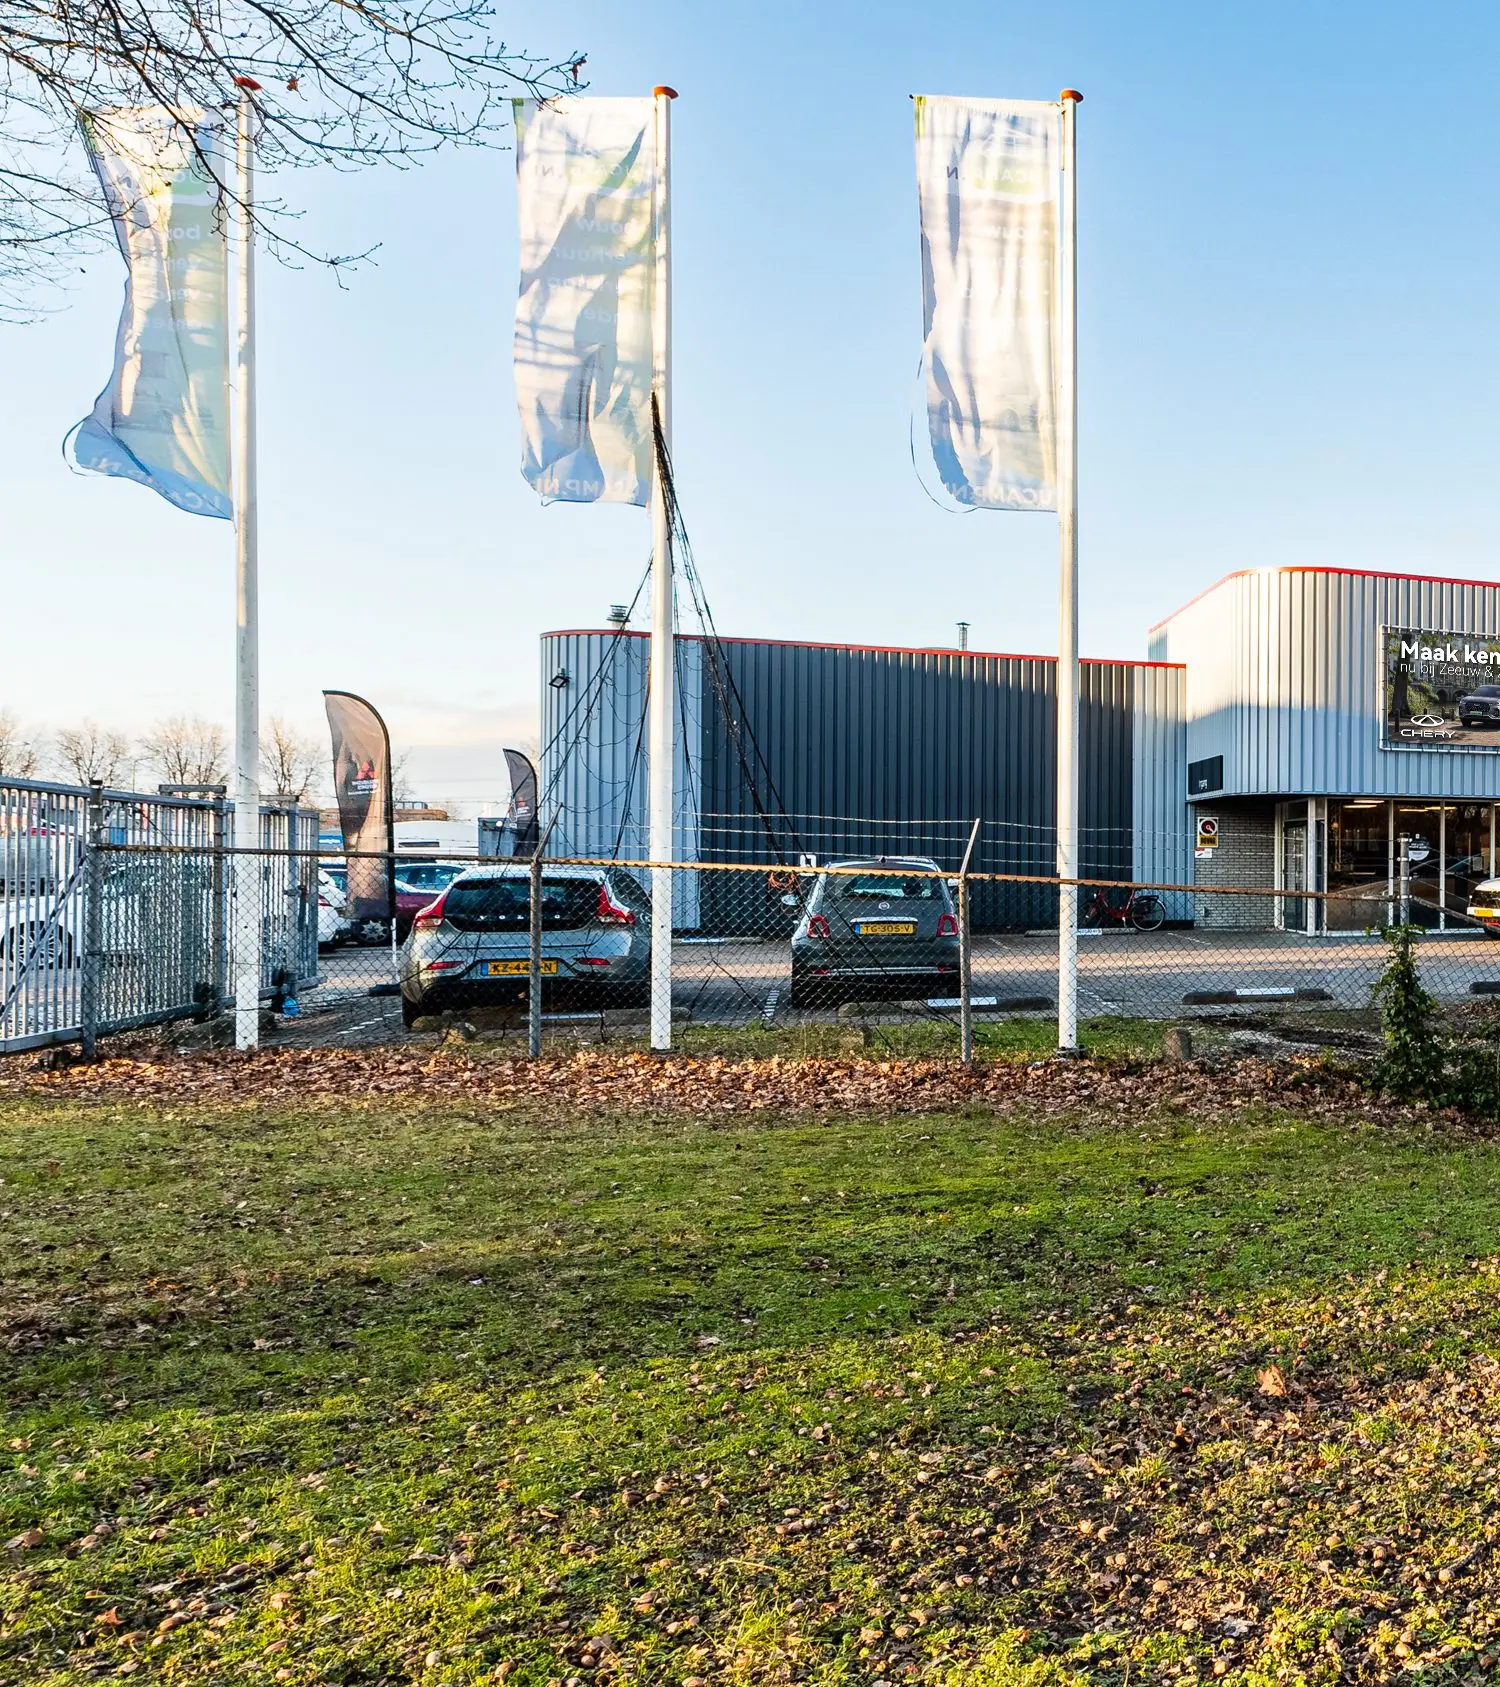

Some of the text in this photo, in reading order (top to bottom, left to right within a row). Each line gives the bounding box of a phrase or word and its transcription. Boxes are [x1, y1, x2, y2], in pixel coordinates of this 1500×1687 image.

[1401, 641, 1459, 663] Maak
[1400, 663, 1416, 673] nu
[1420, 661, 1435, 677] bij
[1440, 663, 1480, 677] Zeeuw
[1484, 666, 1494, 677] &
[1401, 729, 1455, 738] CHERY
